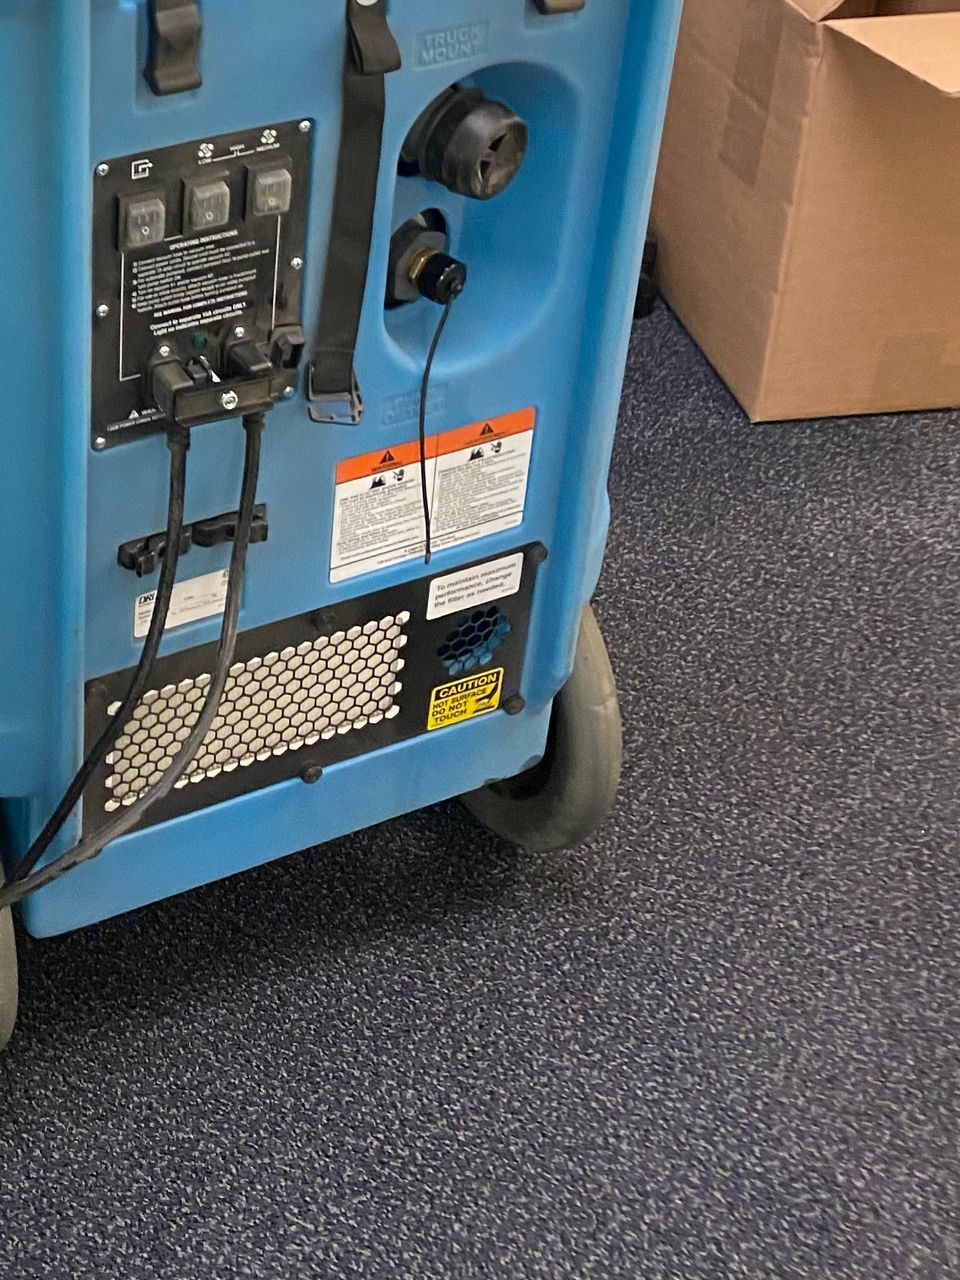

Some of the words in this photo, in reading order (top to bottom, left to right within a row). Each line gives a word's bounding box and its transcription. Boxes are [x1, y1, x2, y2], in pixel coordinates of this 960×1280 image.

[425, 25, 481, 49] TRUCK
[422, 39, 481, 63] MOUNT
[169, 238, 200, 251] OPERATING
[199, 229, 239, 244] INSTRUCTIONS
[150, 320, 172, 331] Connect
[435, 580, 484, 601] performance,
[485, 572, 513, 585] change
[437, 584, 446, 592] To
[447, 574, 479, 588] maintain
[480, 563, 517, 578] maximum
[434, 599, 446, 608] the
[447, 593, 465, 604] filter
[477, 581, 505, 595] needed.
[439, 672, 498, 699] CAUTION
[432, 708, 446, 717] DO
[449, 700, 468, 713] NOT
[433, 699, 450, 710] HOT
[451, 687, 487, 704] SURFACE
[435, 708, 468, 724] TOUCH
